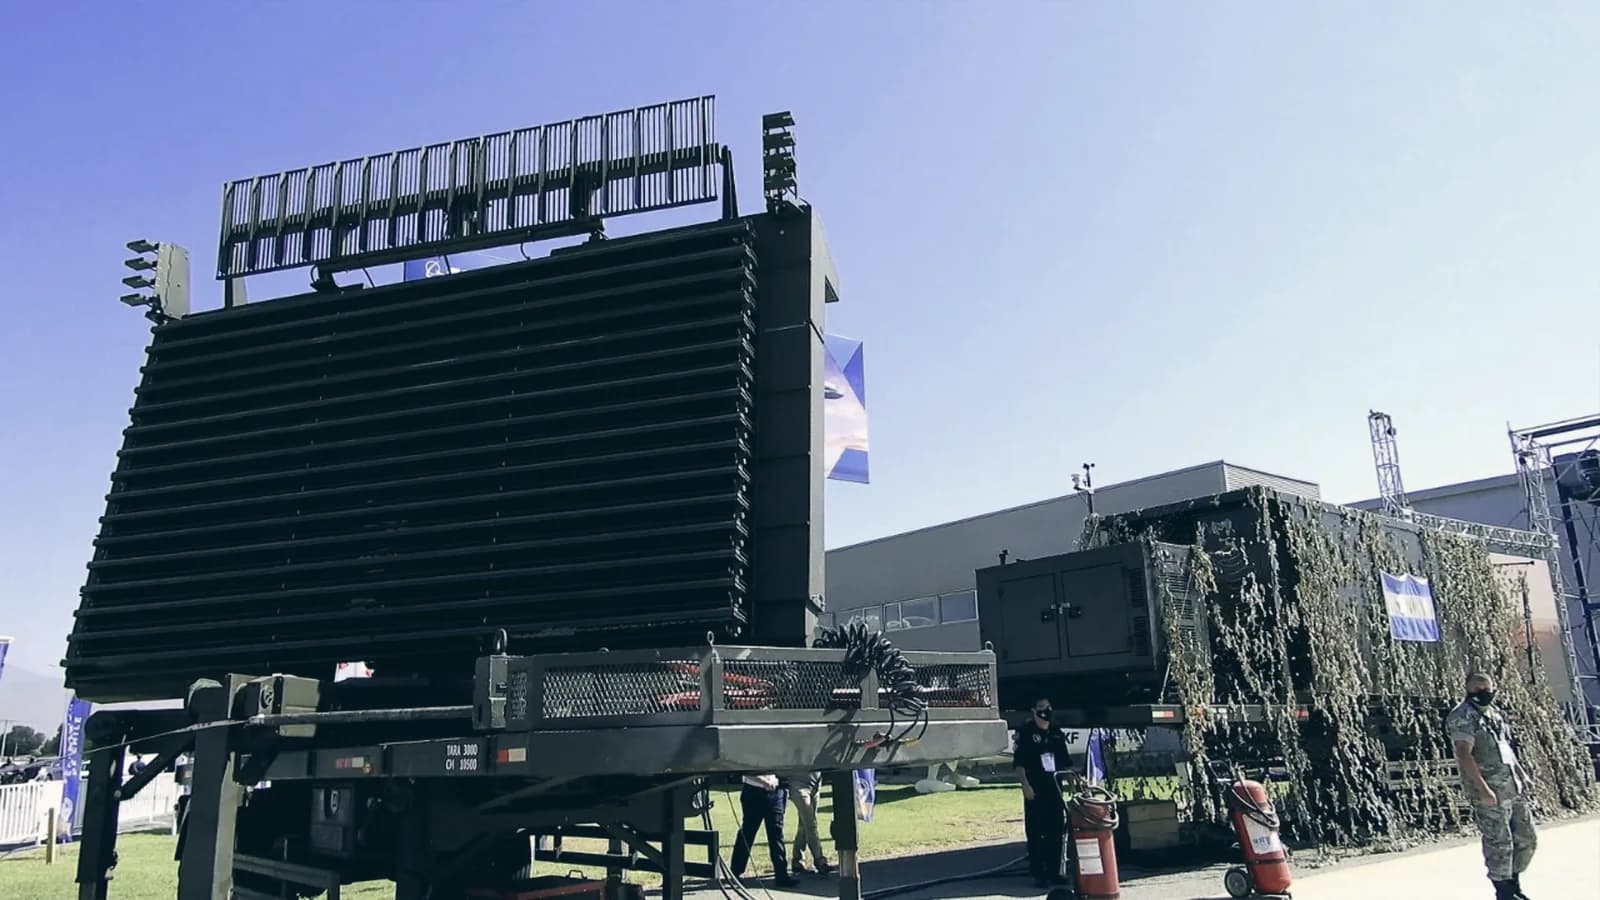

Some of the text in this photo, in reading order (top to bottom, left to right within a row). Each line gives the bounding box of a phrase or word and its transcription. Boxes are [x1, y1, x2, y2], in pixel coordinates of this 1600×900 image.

[71, 716, 82, 755] CHILE
[447, 744, 478, 756] TARA 3000
